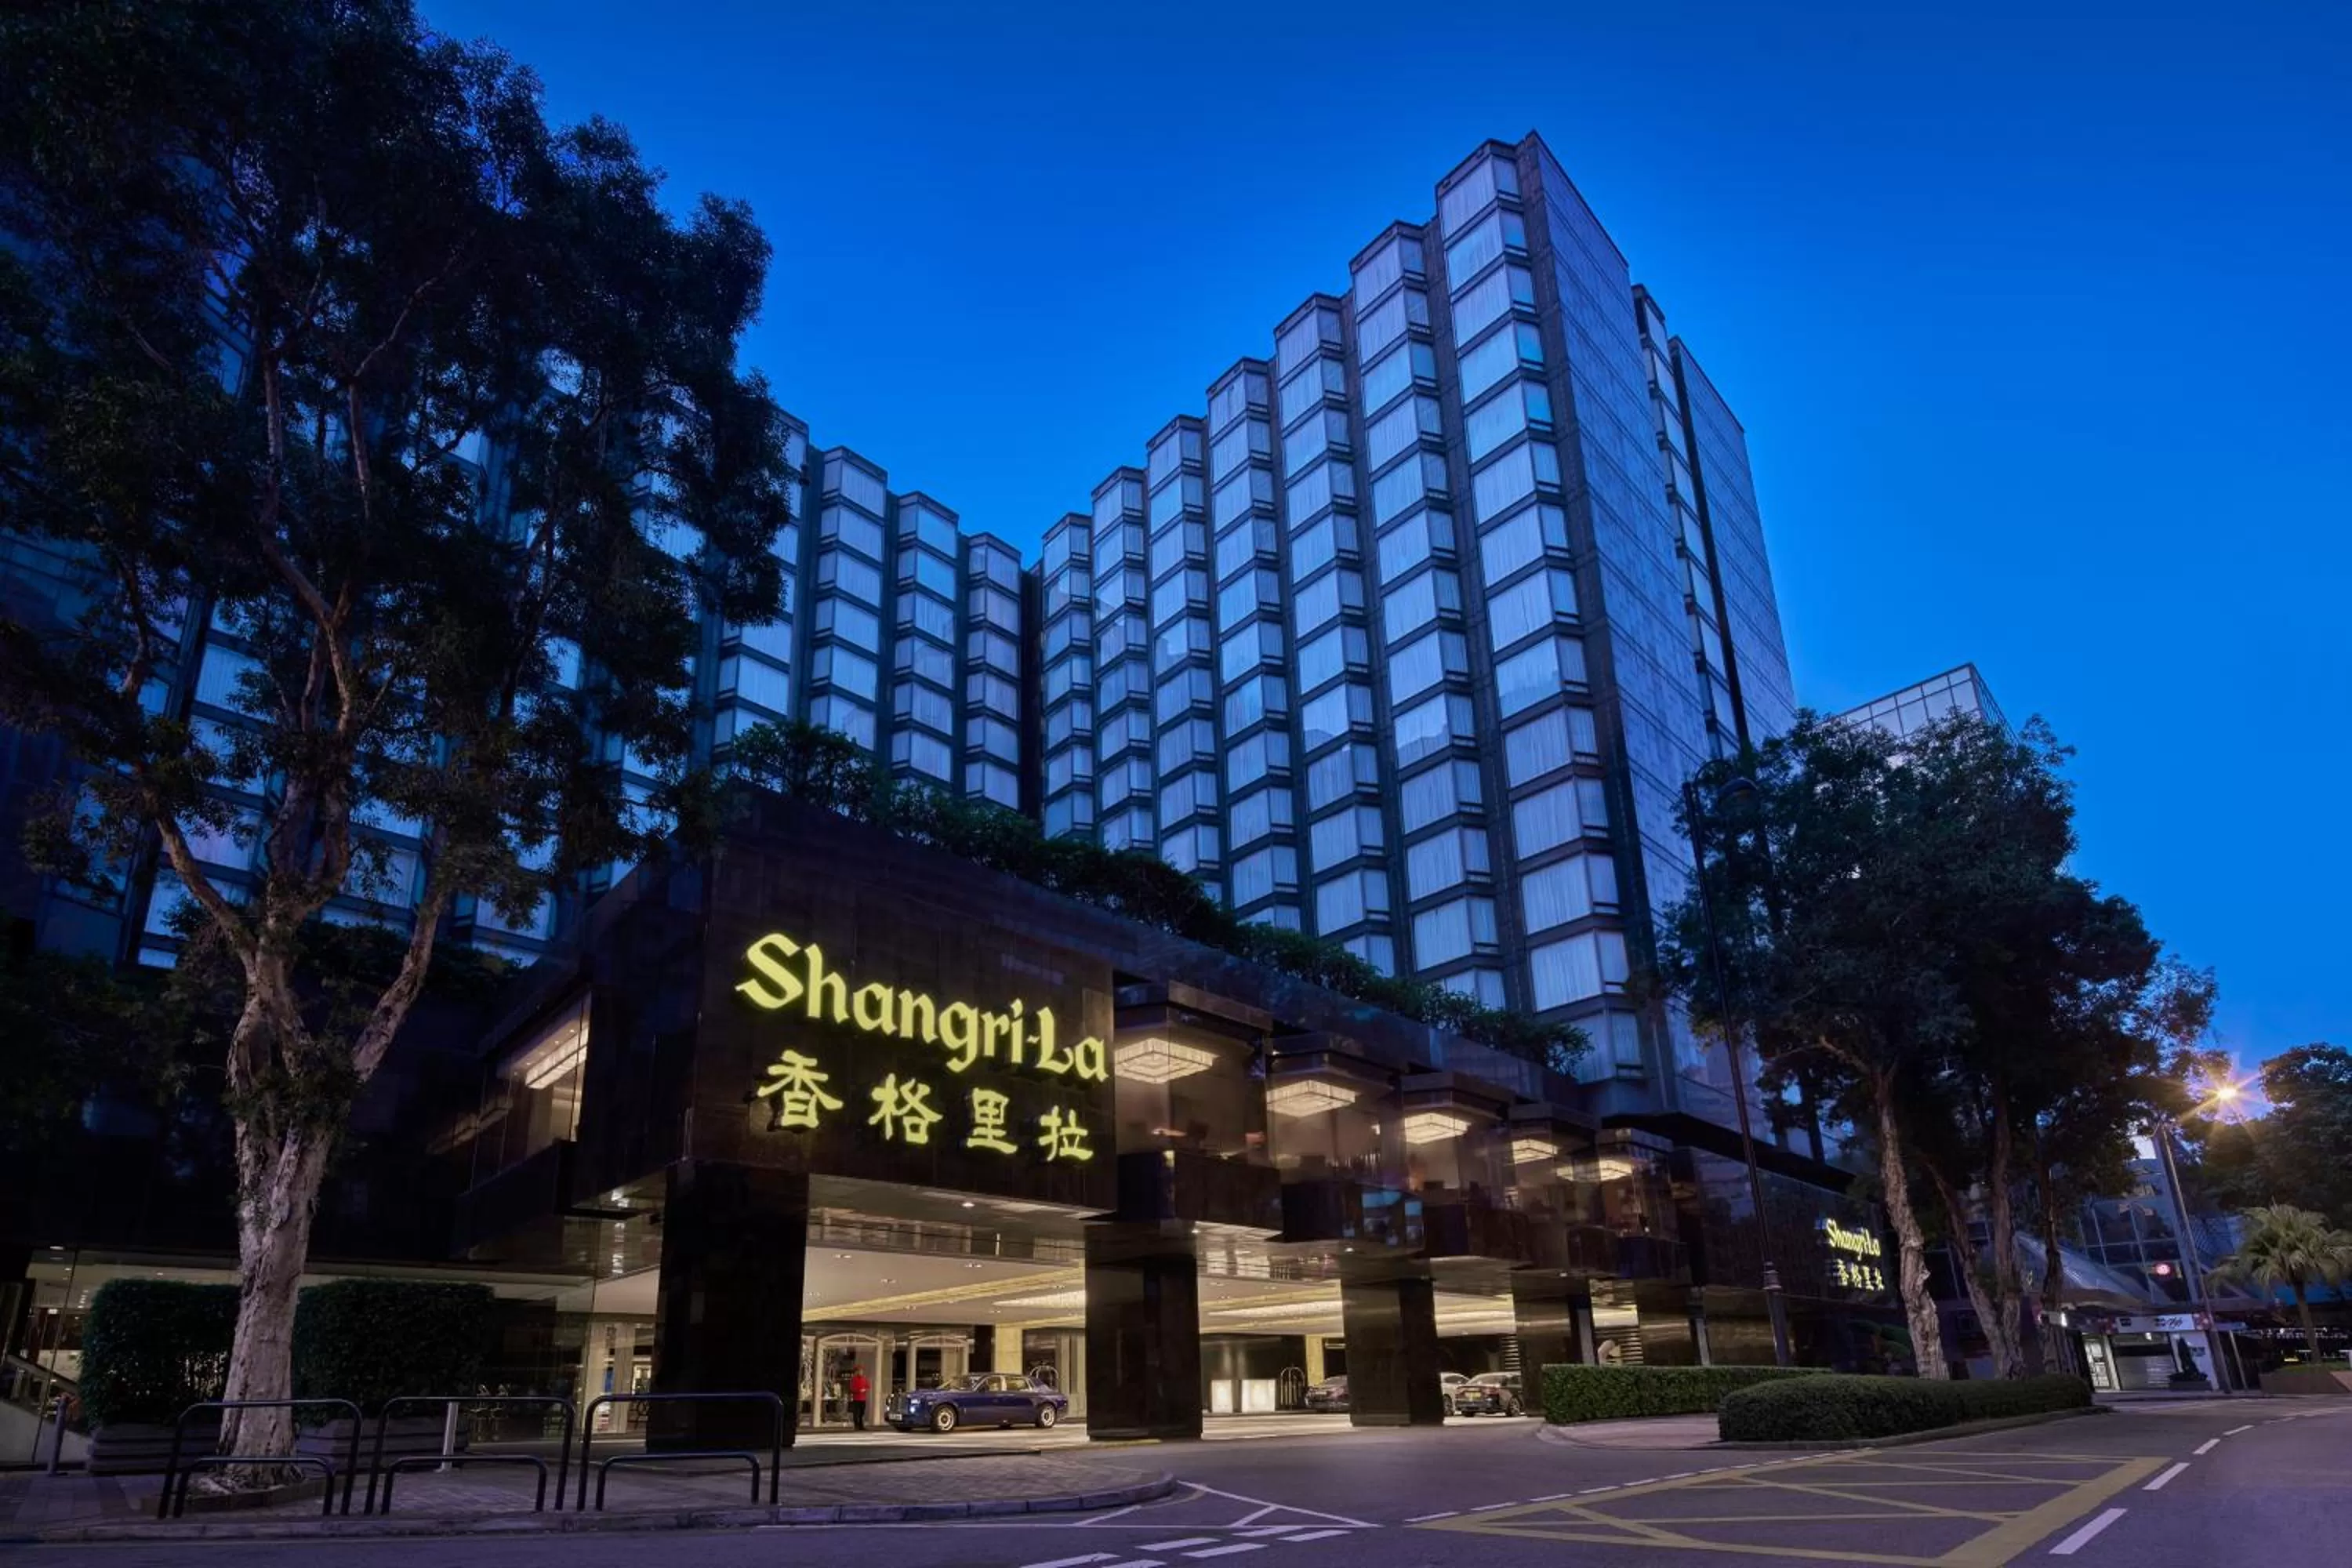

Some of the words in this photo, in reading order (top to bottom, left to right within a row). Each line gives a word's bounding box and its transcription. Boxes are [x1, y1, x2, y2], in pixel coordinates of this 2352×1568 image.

[735, 933, 1109, 1082] Shangri-La
[757, 1050, 1094, 1163] 香格里拉
